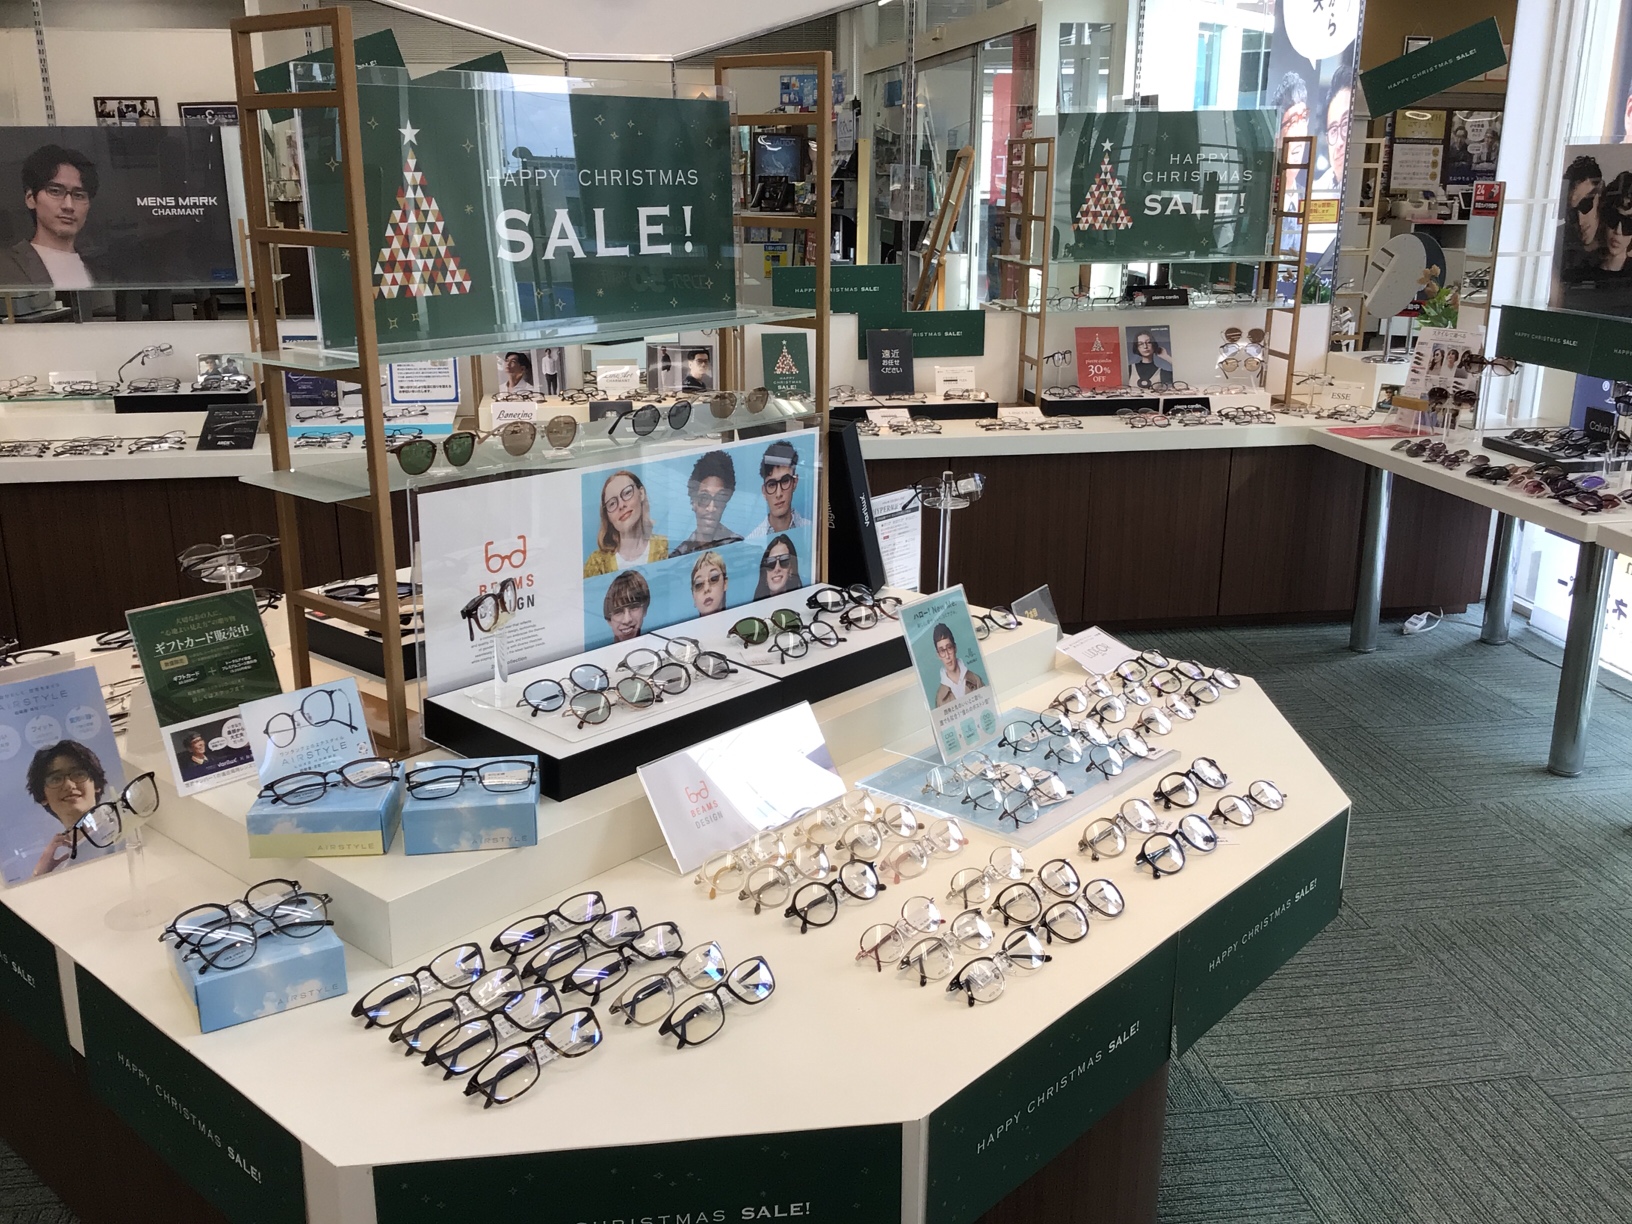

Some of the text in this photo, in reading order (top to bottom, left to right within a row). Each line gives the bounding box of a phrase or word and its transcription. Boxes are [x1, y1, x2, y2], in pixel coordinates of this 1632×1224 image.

[1388, 48, 1476, 90] HAPPY CHRISTMAS SALE!
[1170, 152, 1230, 165] HAPPY
[486, 168, 698, 187] HAPPY CHRISTMAS
[1143, 170, 1253, 183] CHRISTMAS
[136, 196, 218, 206] MENS MARK
[1143, 193, 1246, 216] SALE!
[152, 208, 204, 216] CHARMANT
[496, 205, 693, 262] SALE!
[1531, 334, 1561, 344] CHRISTMAS
[881, 349, 900, 359] 遠近
[1088, 364, 1111, 377] 30%
[1331, 392, 1351, 400] ESSE
[1589, 420, 1610, 433] Calvin
[154, 624, 249, 655] ギフトカード販売中
[282, 741, 348, 766] AIRSTYLE
[690, 800, 718, 817] BEAMS
[695, 811, 723, 829] DESIGN
[317, 842, 375, 852] AIRSTYLE
[472, 835, 527, 844] AIRSTYLE
[1208, 878, 1318, 972] HAPPY CHRISTMAS SALE!
[12, 961, 36, 988] SALE!
[277, 983, 339, 1006] AIRSTYLE
[976, 1020, 1141, 1154] HAPPY CHRISTMAS SALE!
[117, 1052, 262, 1184] HAPPY CHRISTMAS SALE!
[741, 1202, 811, 1220] SALE!
